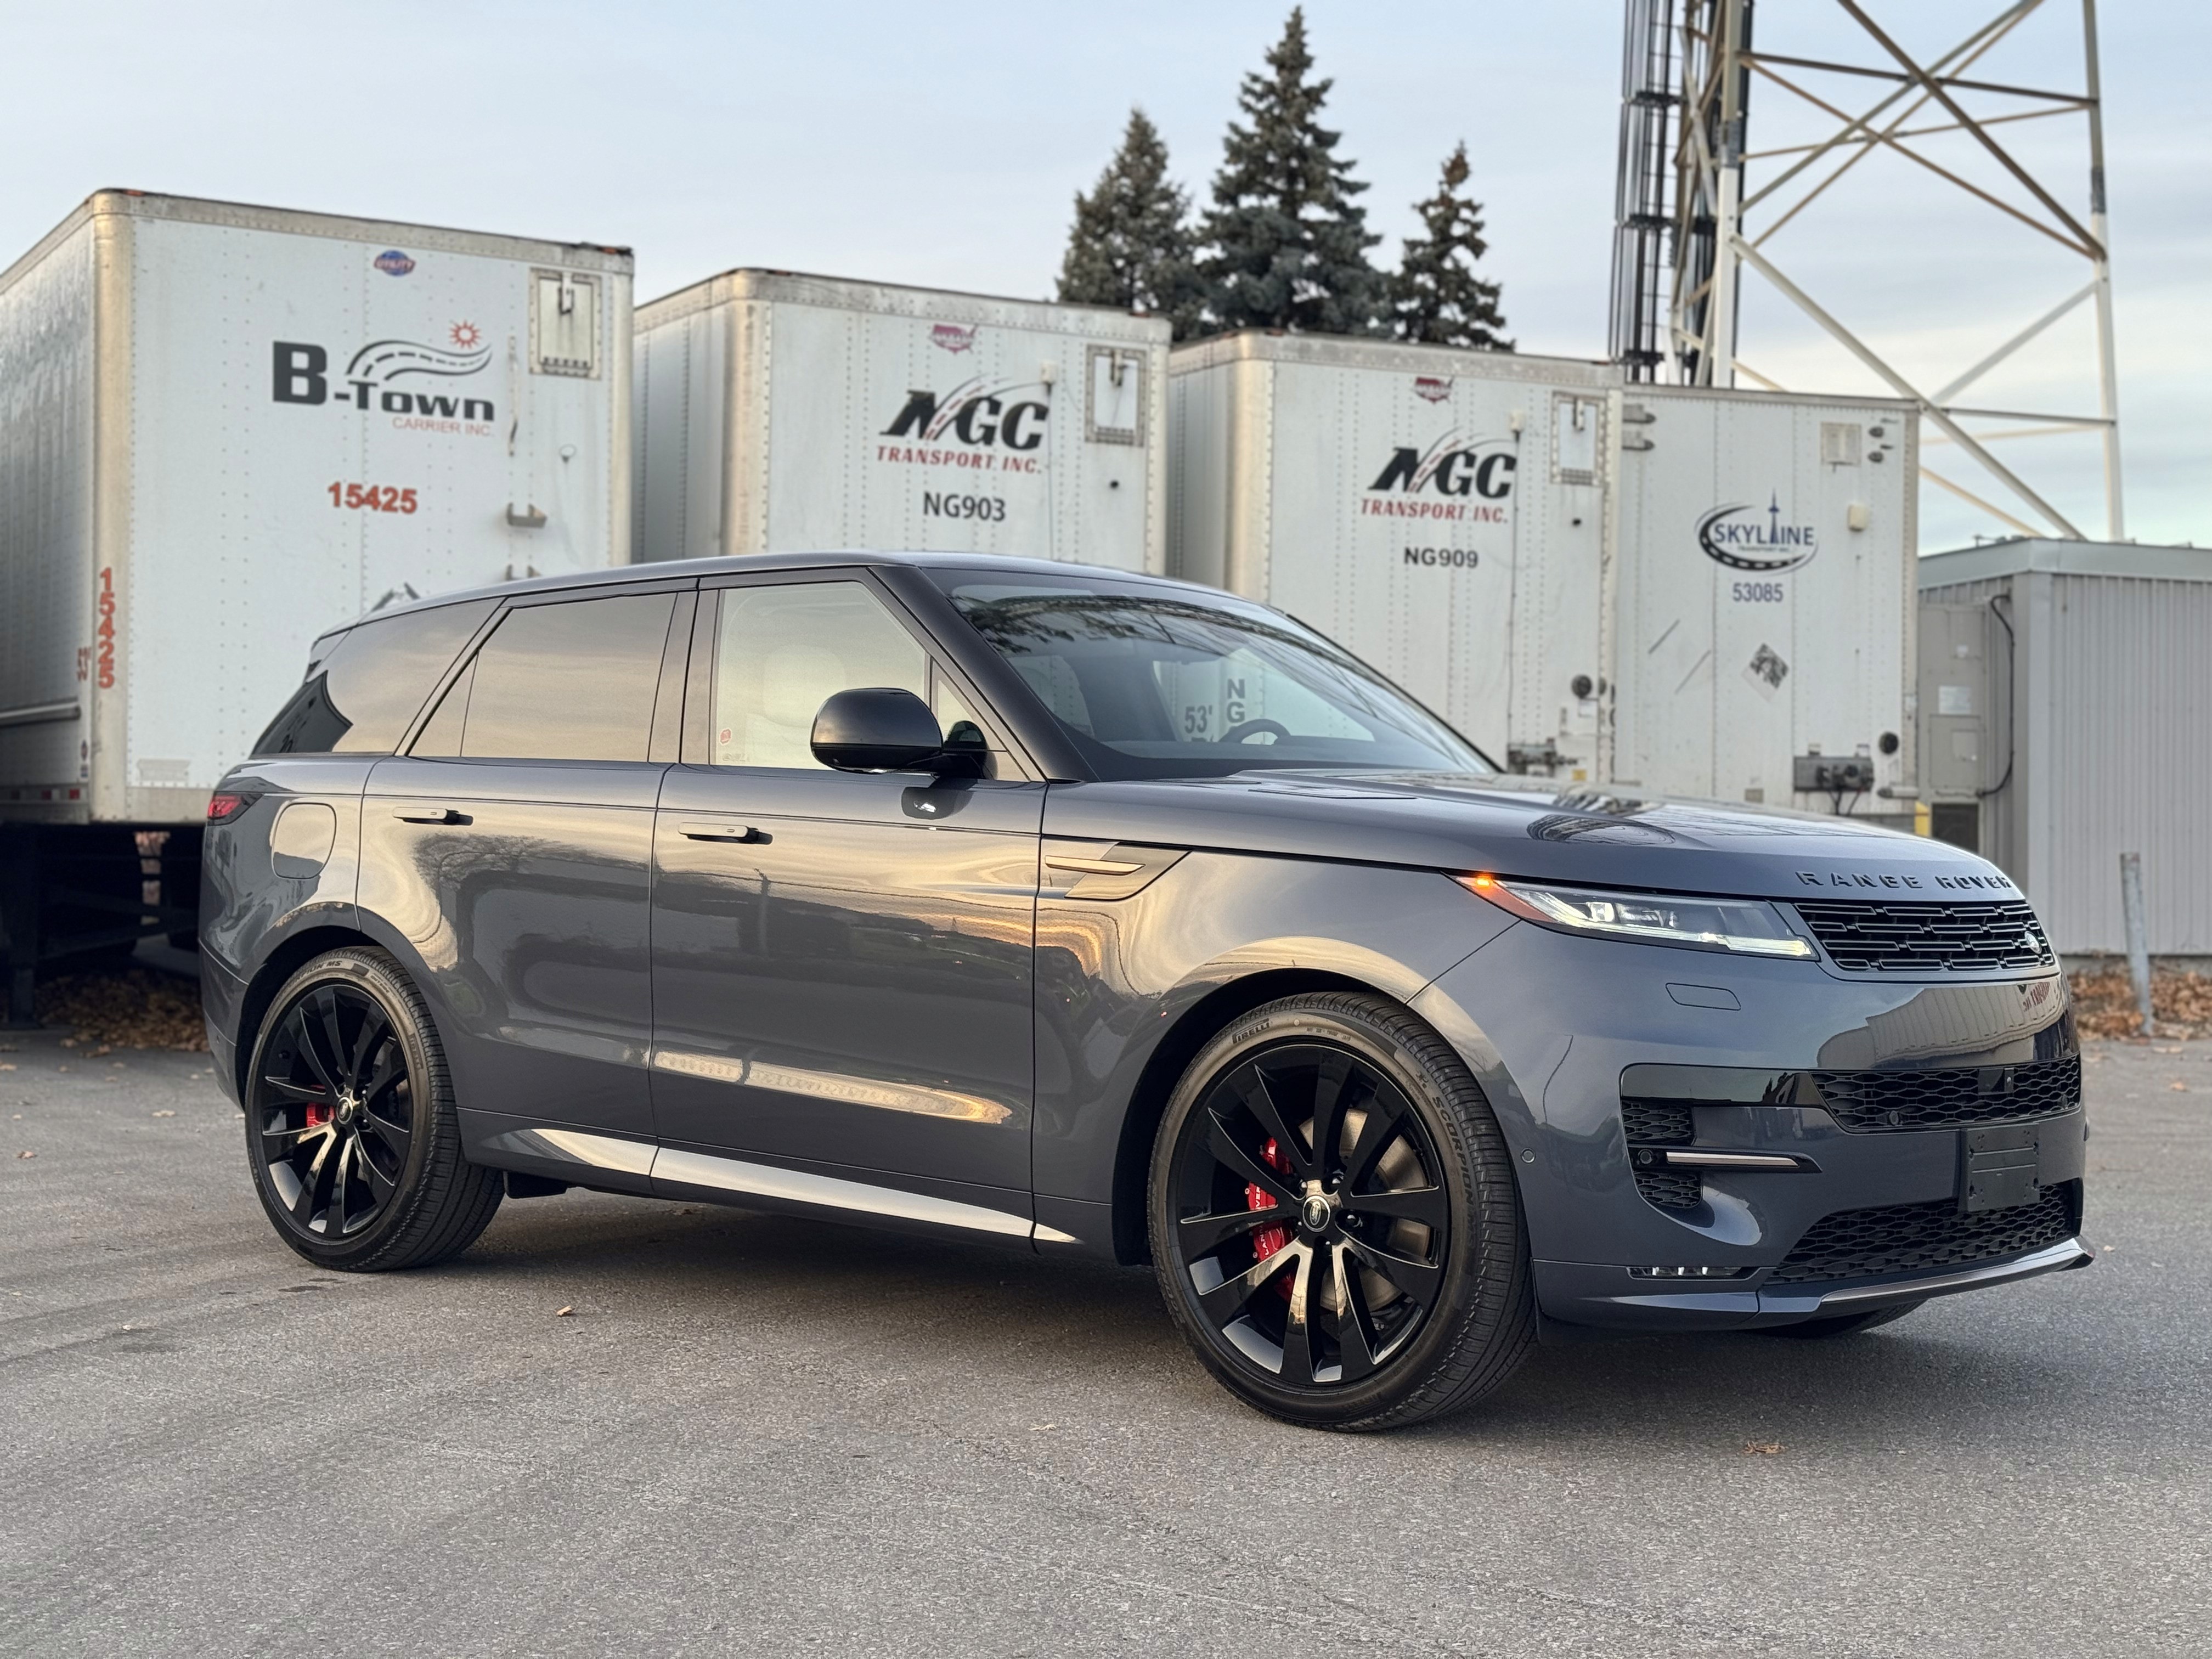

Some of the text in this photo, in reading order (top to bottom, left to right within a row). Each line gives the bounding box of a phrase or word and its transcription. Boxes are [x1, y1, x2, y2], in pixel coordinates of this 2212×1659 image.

[392, 416, 460, 435] CARRIER
[879, 389, 1048, 450] NGC
[877, 445, 1042, 475] TRANSPORT INC.
[1367, 447, 1516, 499] NGC
[328, 481, 417, 515] 15425
[924, 492, 1006, 522] NG903
[1361, 498, 1508, 523] TRANSPORT INC.
[1714, 523, 1814, 546] SKYLINE
[1404, 548, 1478, 568] NG909
[1733, 583, 1783, 602] 53085
[98, 567, 116, 689] 15425
[1795, 871, 2012, 889] RANGE ROVER
[1232, 1018, 1271, 1043] PIRELLI
[1432, 1096, 1474, 1205] SCORPION
